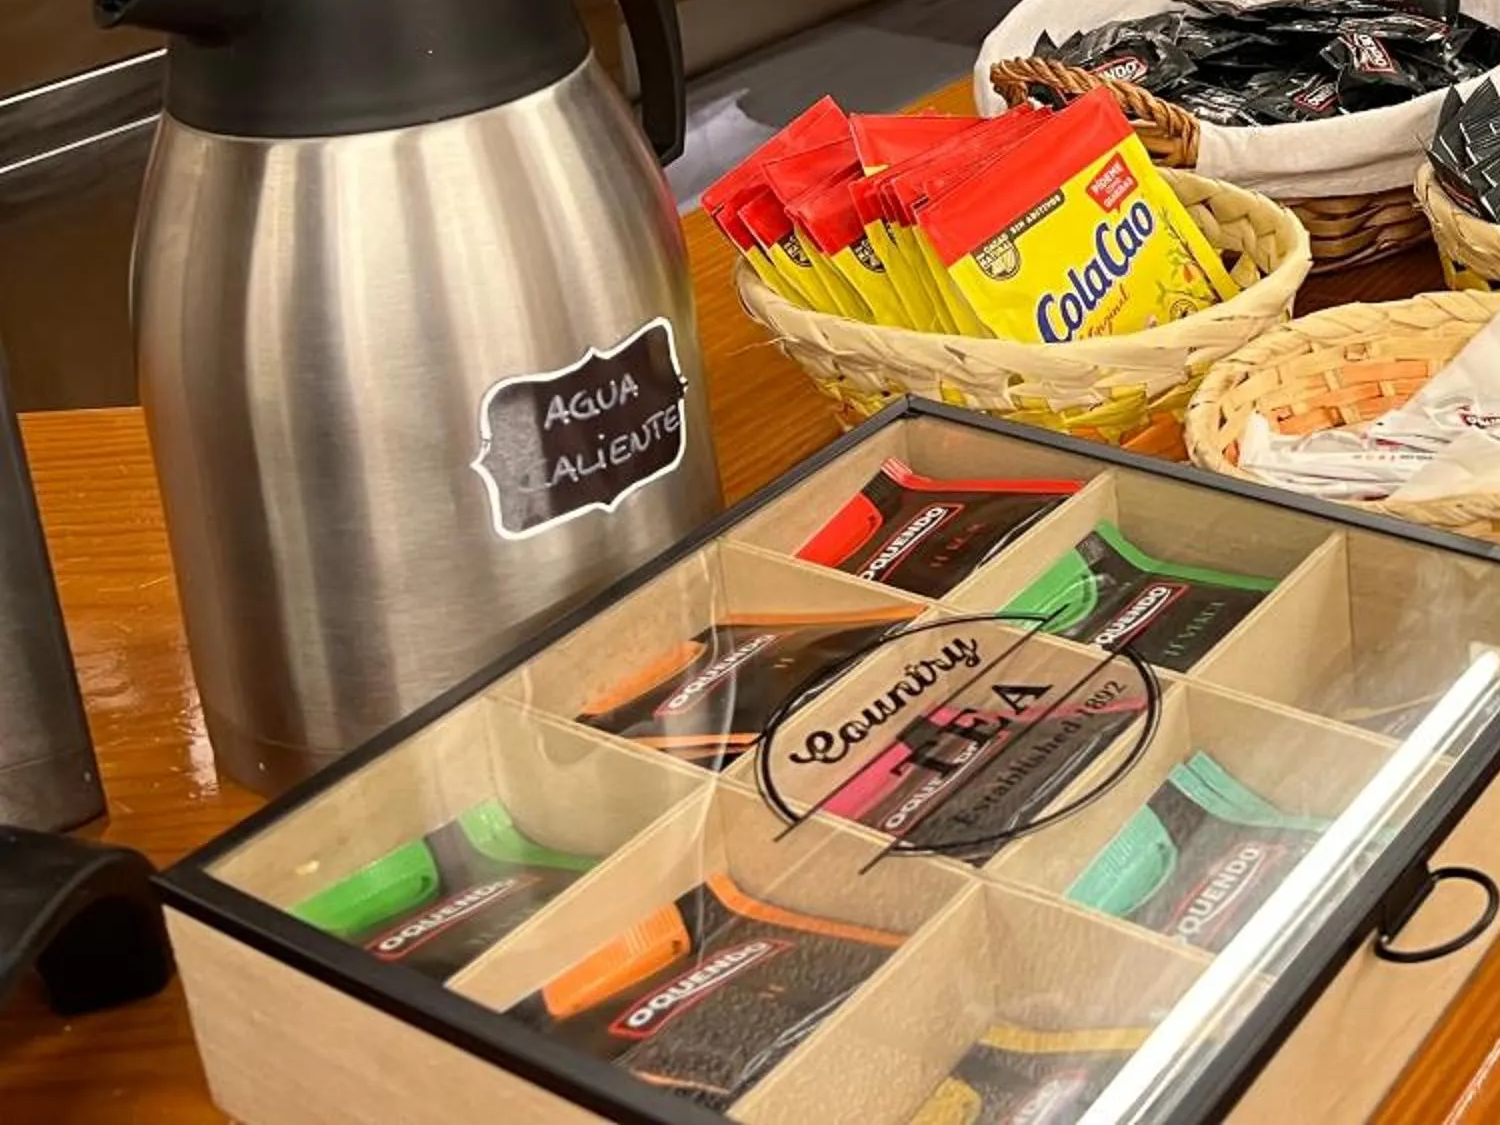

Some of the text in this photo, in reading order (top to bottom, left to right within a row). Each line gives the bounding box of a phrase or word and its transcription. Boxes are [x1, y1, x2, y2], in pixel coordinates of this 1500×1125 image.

[1037, 201, 1153, 343] ColaCao
[543, 373, 639, 430] AGUA
[1095, 586, 1168, 650] QUENDO
[790, 637, 978, 764] Country
[891, 683, 1054, 780] TEA
[954, 680, 1128, 827] Established 1892
[1176, 844, 1263, 947] QUENDO
[627, 941, 769, 1028] OQUENDO
